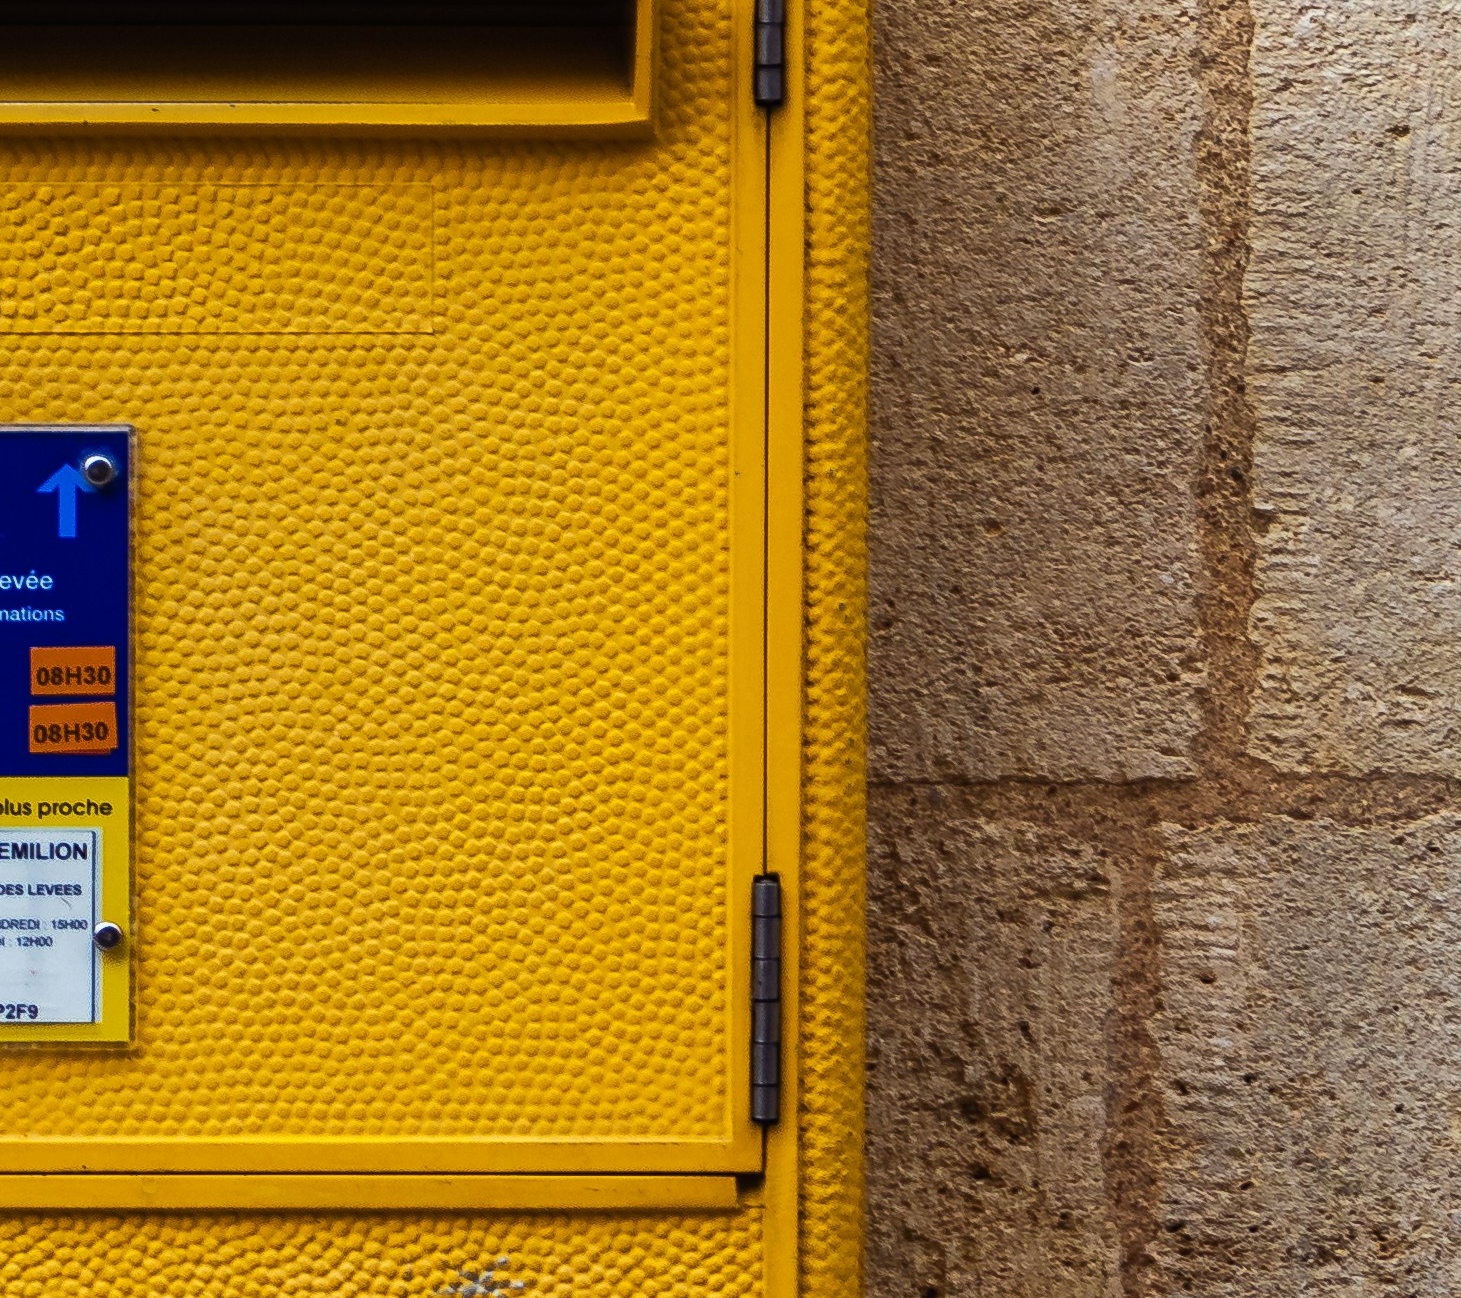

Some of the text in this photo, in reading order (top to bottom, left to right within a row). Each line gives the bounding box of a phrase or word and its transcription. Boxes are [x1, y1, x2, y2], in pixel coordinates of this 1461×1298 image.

[36, 666, 112, 686] 08H30
[33, 722, 109, 744] 08H30
[38, 799, 113, 819] proche
[28, 884, 82, 896] LEVEES
[17, 936, 53, 947] 12H00
